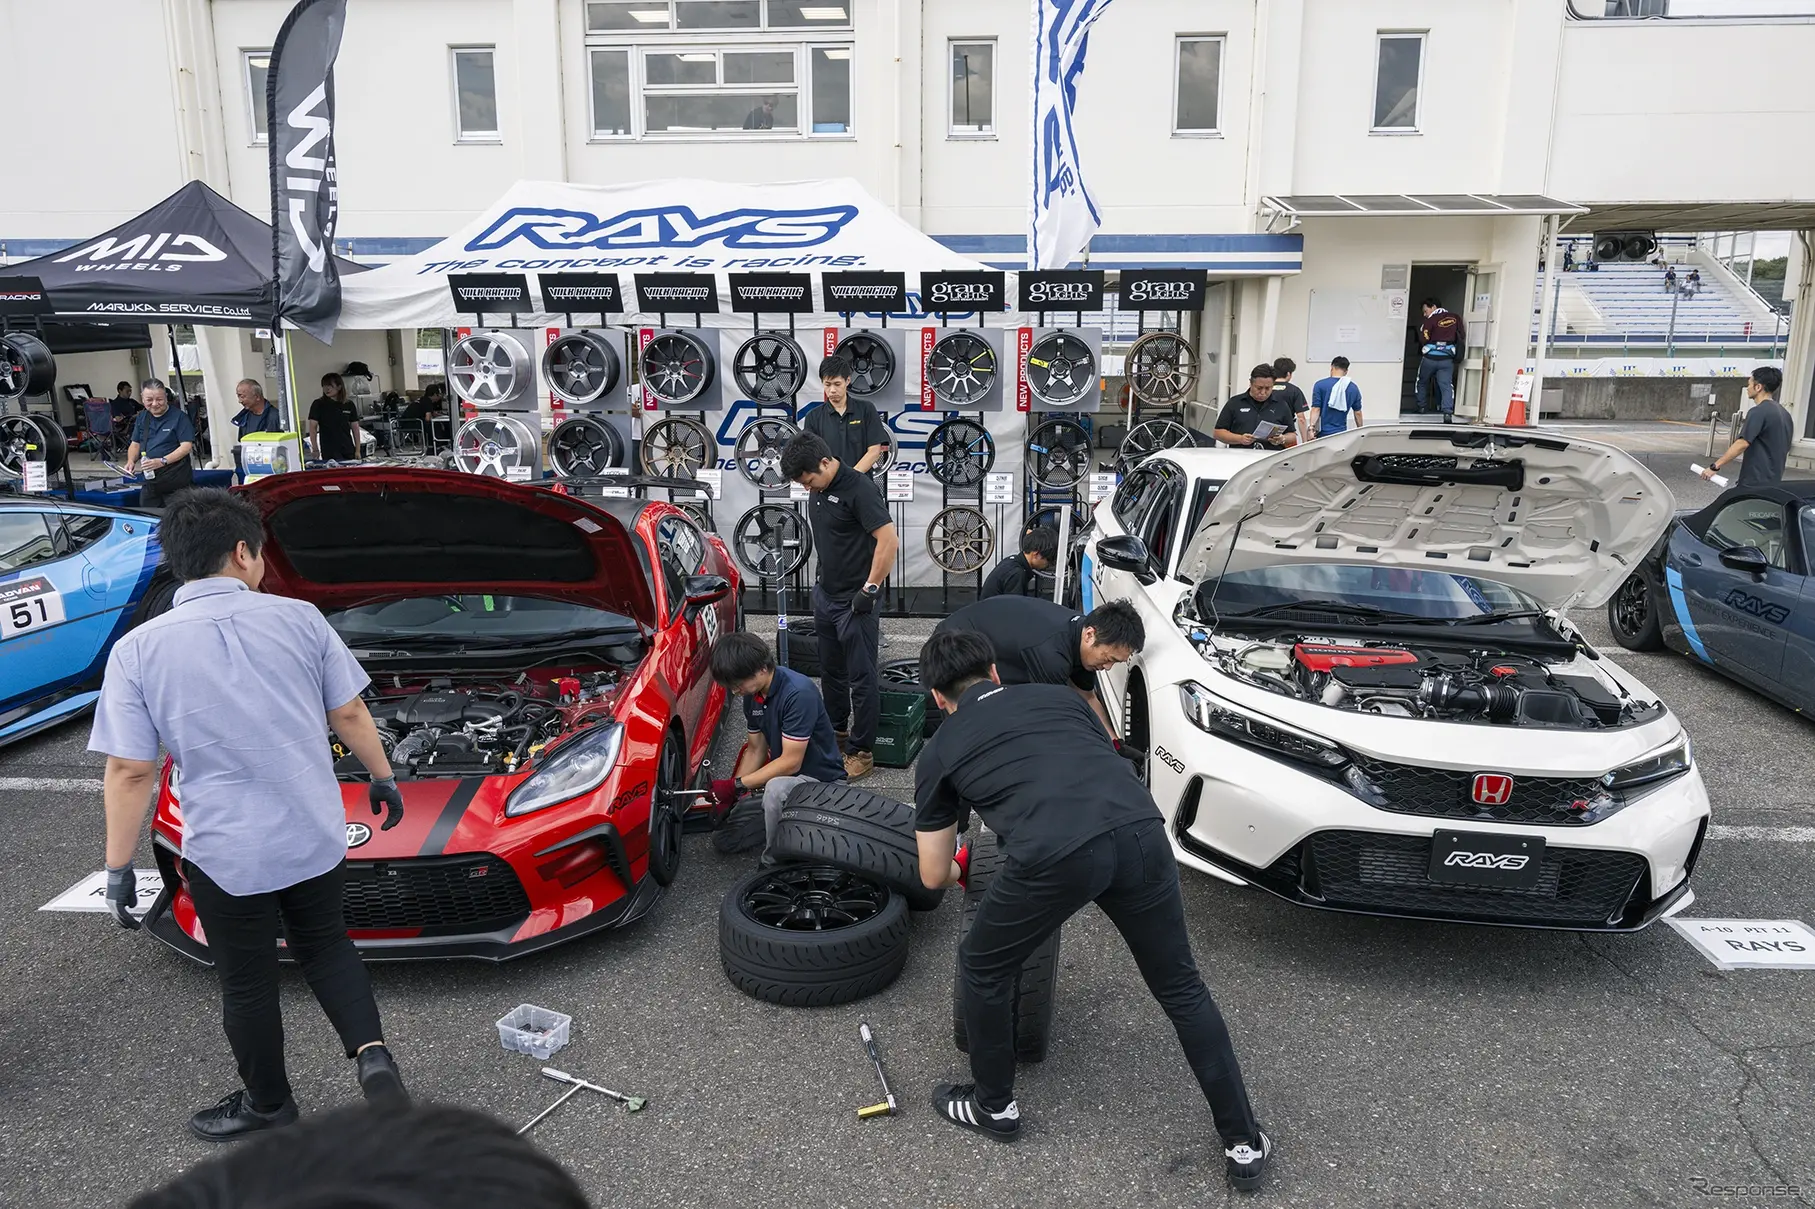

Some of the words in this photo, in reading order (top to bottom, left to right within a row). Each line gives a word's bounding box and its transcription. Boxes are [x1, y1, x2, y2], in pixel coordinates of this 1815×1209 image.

[463, 204, 859, 252] RAYS
[52, 232, 228, 263] MID
[75, 263, 183, 273] WHEELS
[416, 259, 489, 275] The
[494, 254, 668, 270] concept
[673, 254, 715, 269] is
[721, 253, 868, 269] racing.
[931, 281, 994, 303] gram
[1028, 280, 1093, 303] gram
[1048, 290, 1088, 298] LIGHTS
[1129, 279, 1195, 302] gram
[1149, 289, 1189, 298] LIGHTS
[86, 302, 157, 312] MARUKA
[159, 303, 223, 315] SERVICE
[924, 384, 932, 406] NEW
[1019, 385, 1028, 408] NEW
[10, 598, 47, 629] 51
[1724, 588, 1791, 625] RAYS
[1154, 745, 1186, 775] RAYS
[607, 780, 648, 816] RAYS
[1444, 851, 1530, 870] RAYS
[1724, 939, 1807, 952] RAYS
